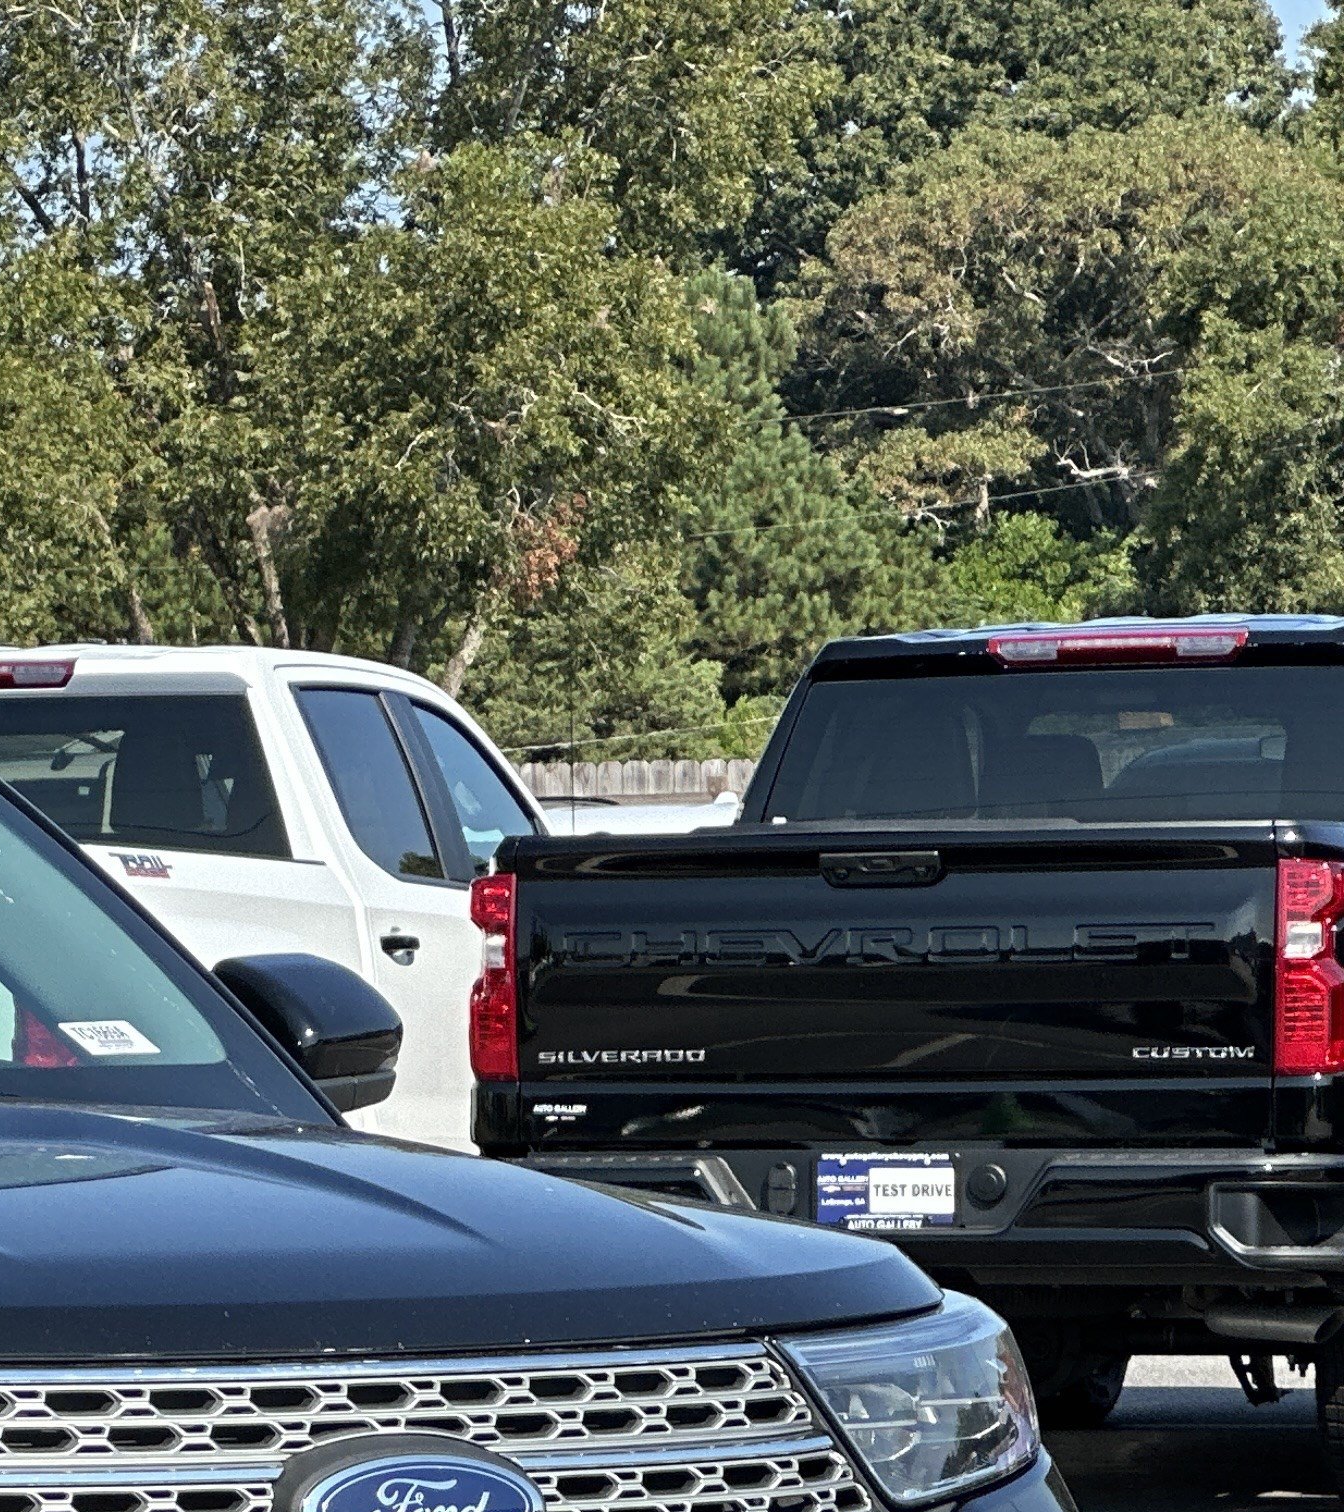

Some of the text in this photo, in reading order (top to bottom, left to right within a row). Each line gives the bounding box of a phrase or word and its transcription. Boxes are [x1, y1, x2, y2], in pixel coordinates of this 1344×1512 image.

[563, 922, 1215, 967] CHEVROLET
[538, 1049, 706, 1065] SILVERADO
[1132, 1045, 1255, 1059] CUSTOM
[873, 1184, 953, 1197] TEST DRIVE
